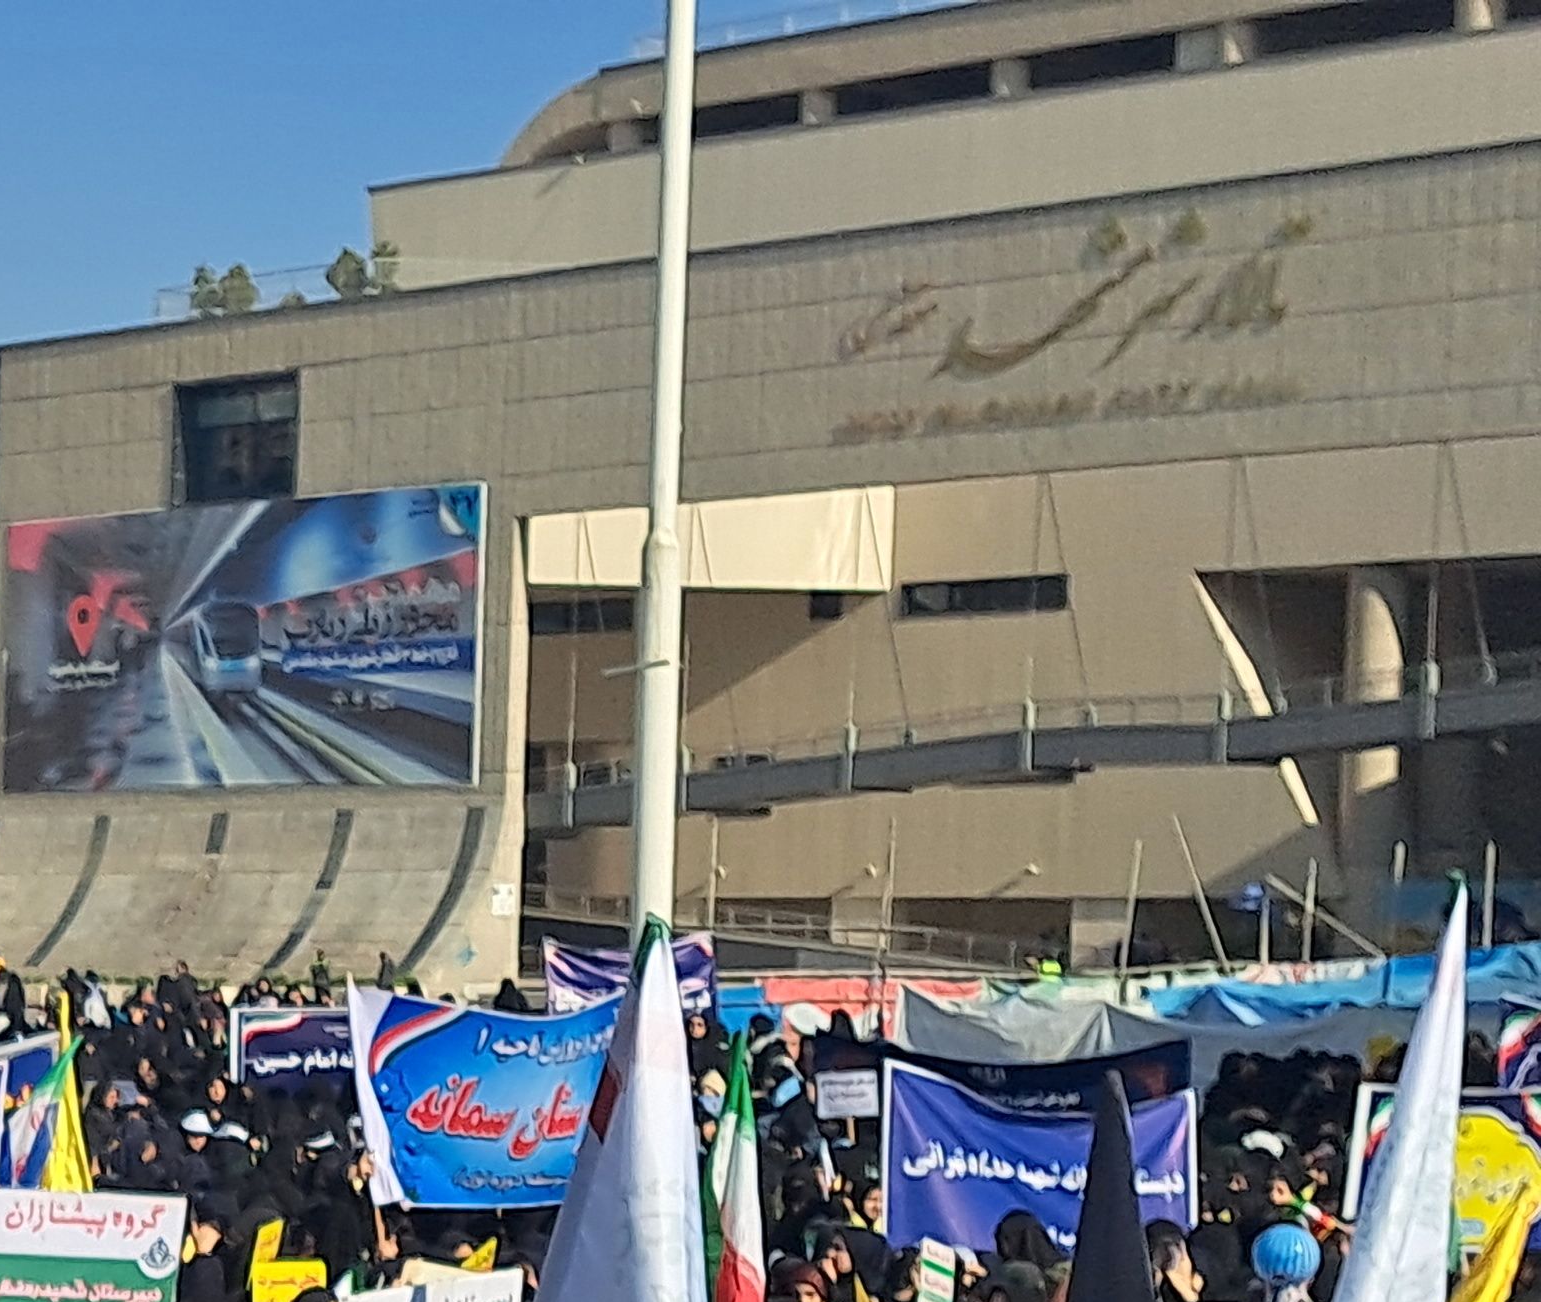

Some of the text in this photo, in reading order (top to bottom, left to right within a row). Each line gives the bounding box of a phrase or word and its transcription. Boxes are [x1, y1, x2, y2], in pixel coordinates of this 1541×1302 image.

[406, 1073, 518, 1140] سمانه
[4, 1199, 167, 1240] گروه پیشتازان
